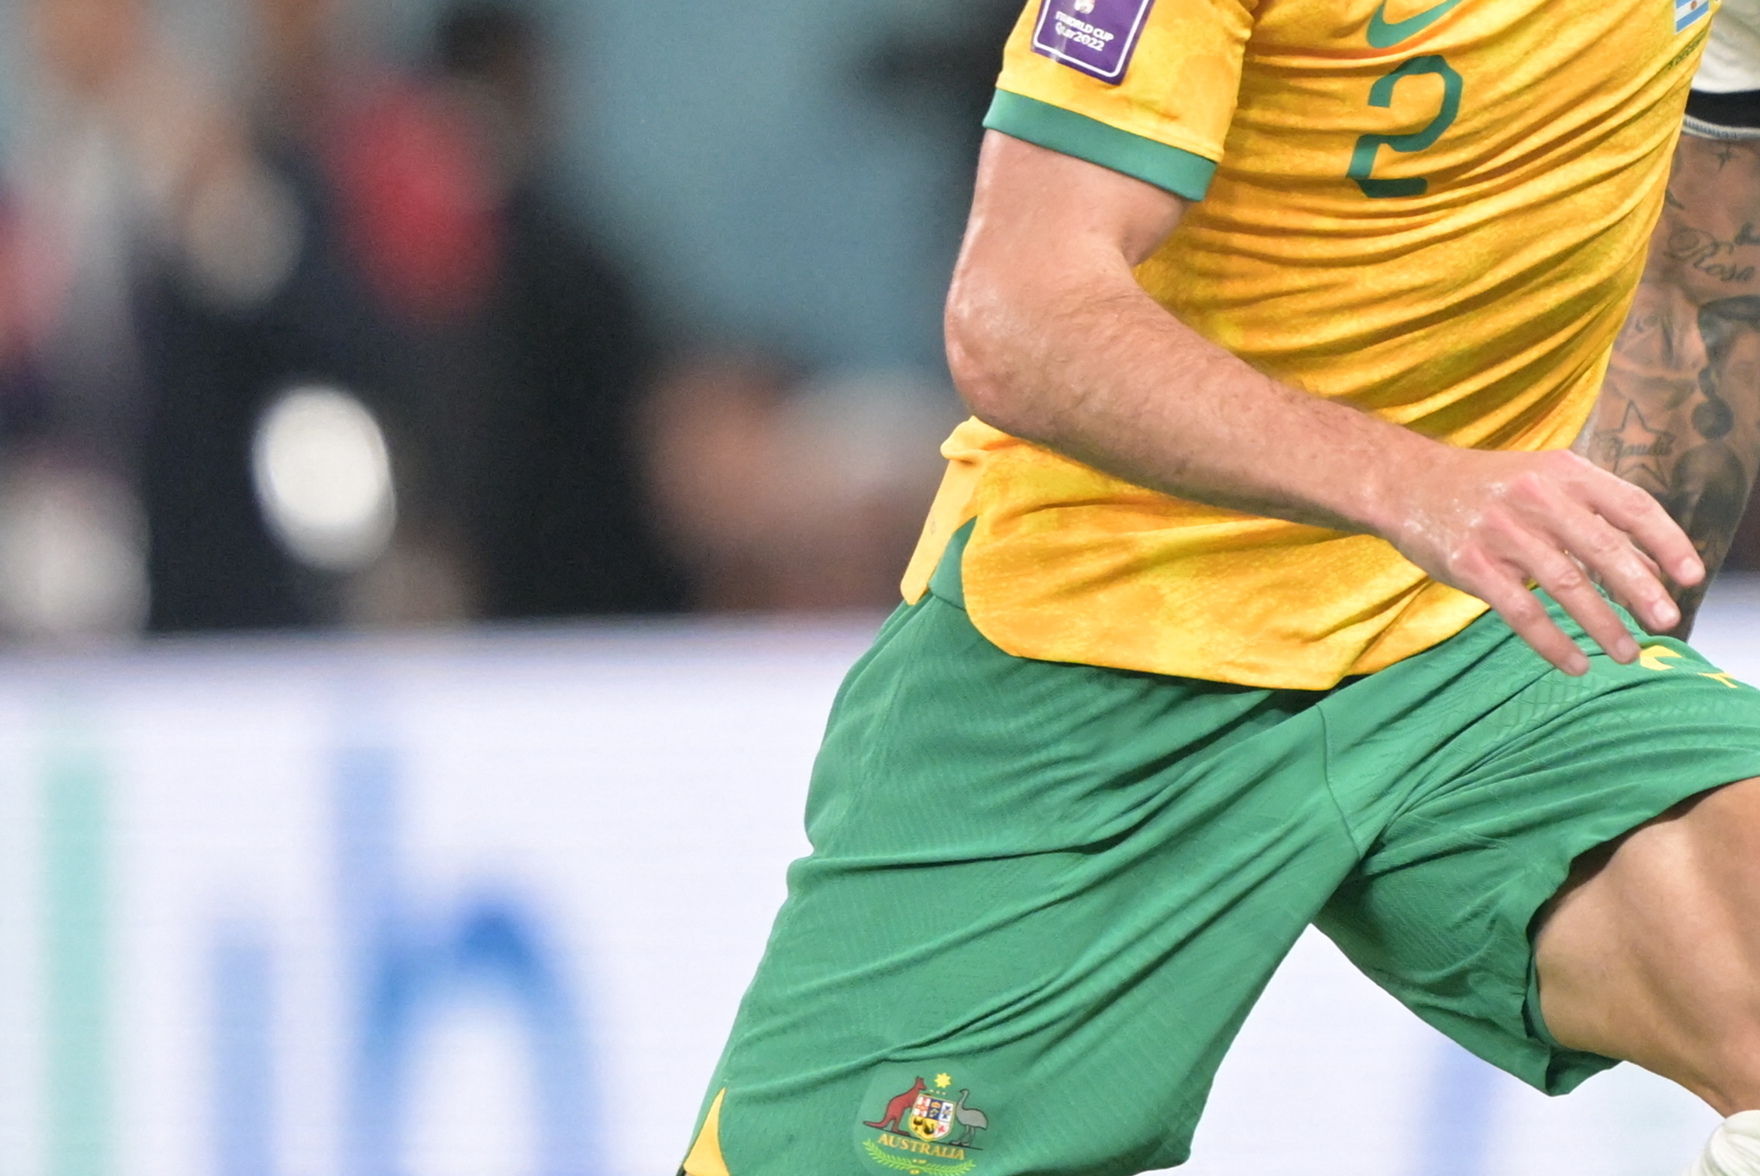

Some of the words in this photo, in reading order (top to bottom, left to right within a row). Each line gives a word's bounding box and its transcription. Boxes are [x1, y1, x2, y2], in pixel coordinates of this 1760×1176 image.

[1093, 25, 1115, 43] CUP
[1346, 55, 1463, 198] 2
[877, 1132, 966, 1161] AUSTRALIA
